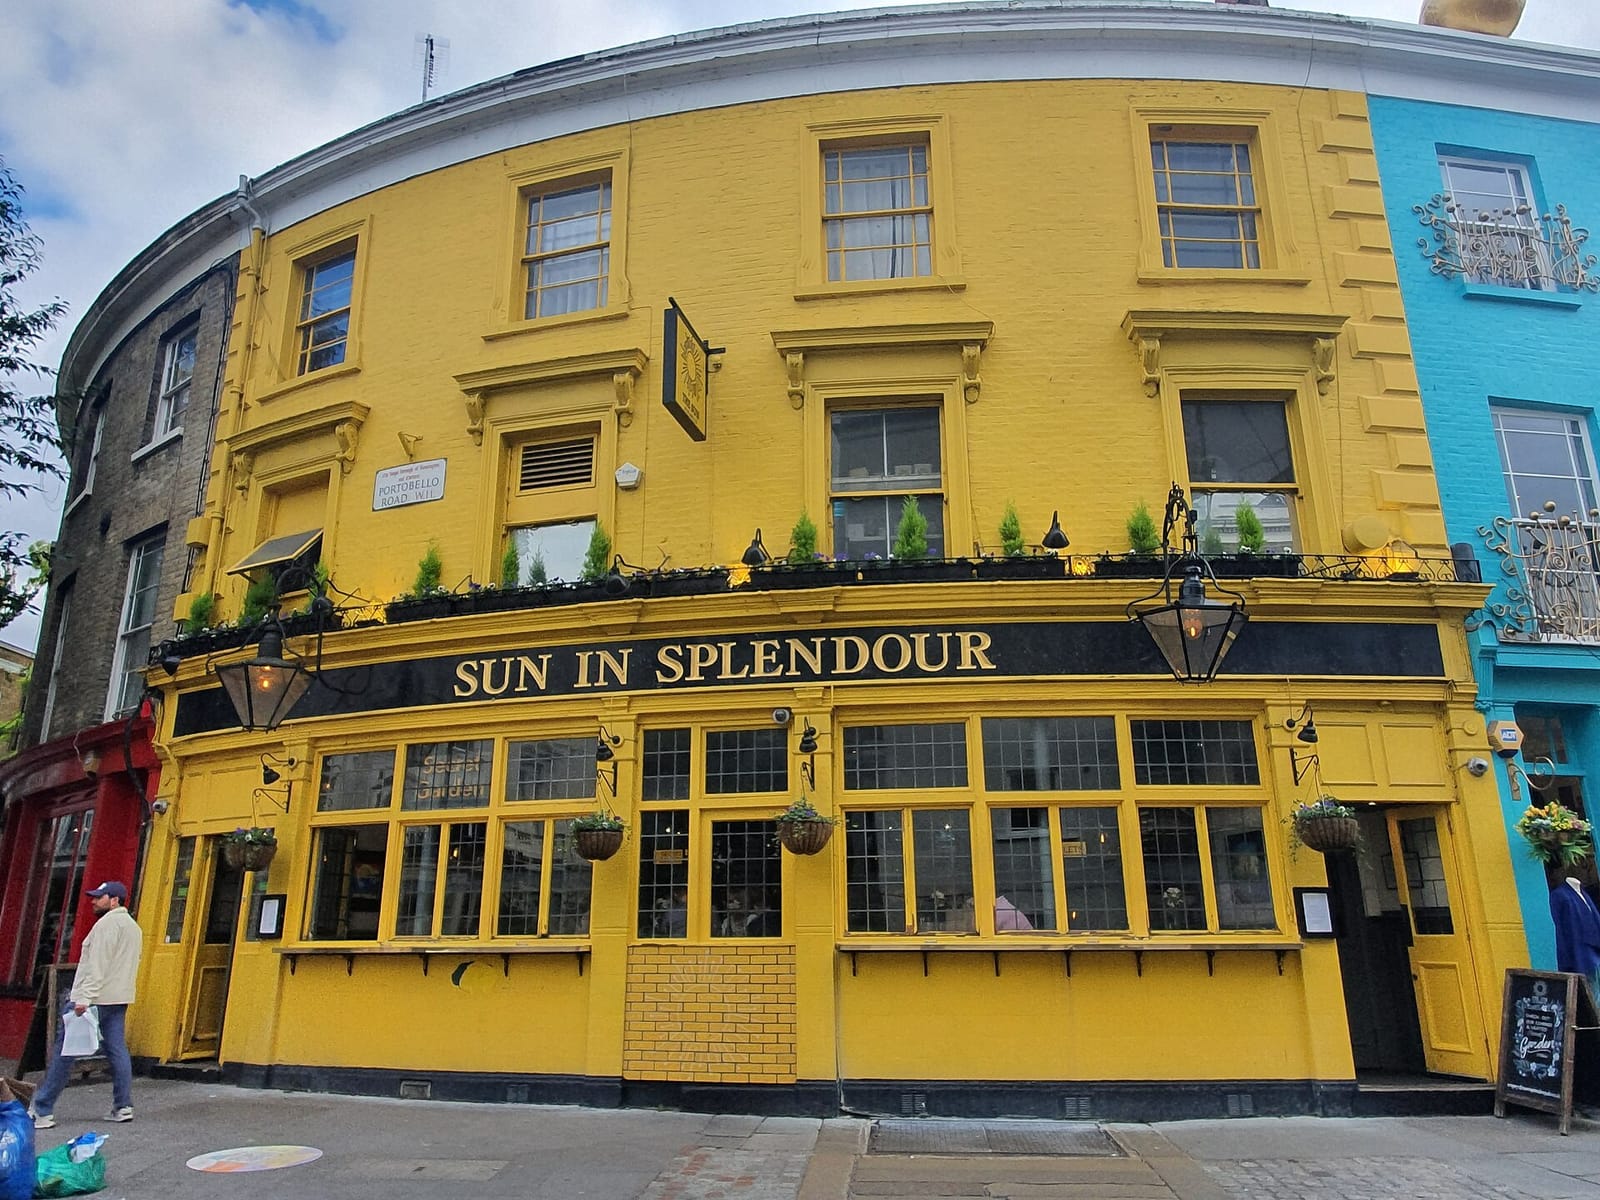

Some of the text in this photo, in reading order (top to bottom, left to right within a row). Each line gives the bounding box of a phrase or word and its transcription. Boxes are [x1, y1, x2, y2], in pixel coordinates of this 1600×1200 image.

[379, 476, 440, 496] PORTOBELLO
[453, 631, 997, 697] SUN IN SPLENDOUR
[423, 755, 480, 774] Secret
[418, 775, 485, 799] Garden
